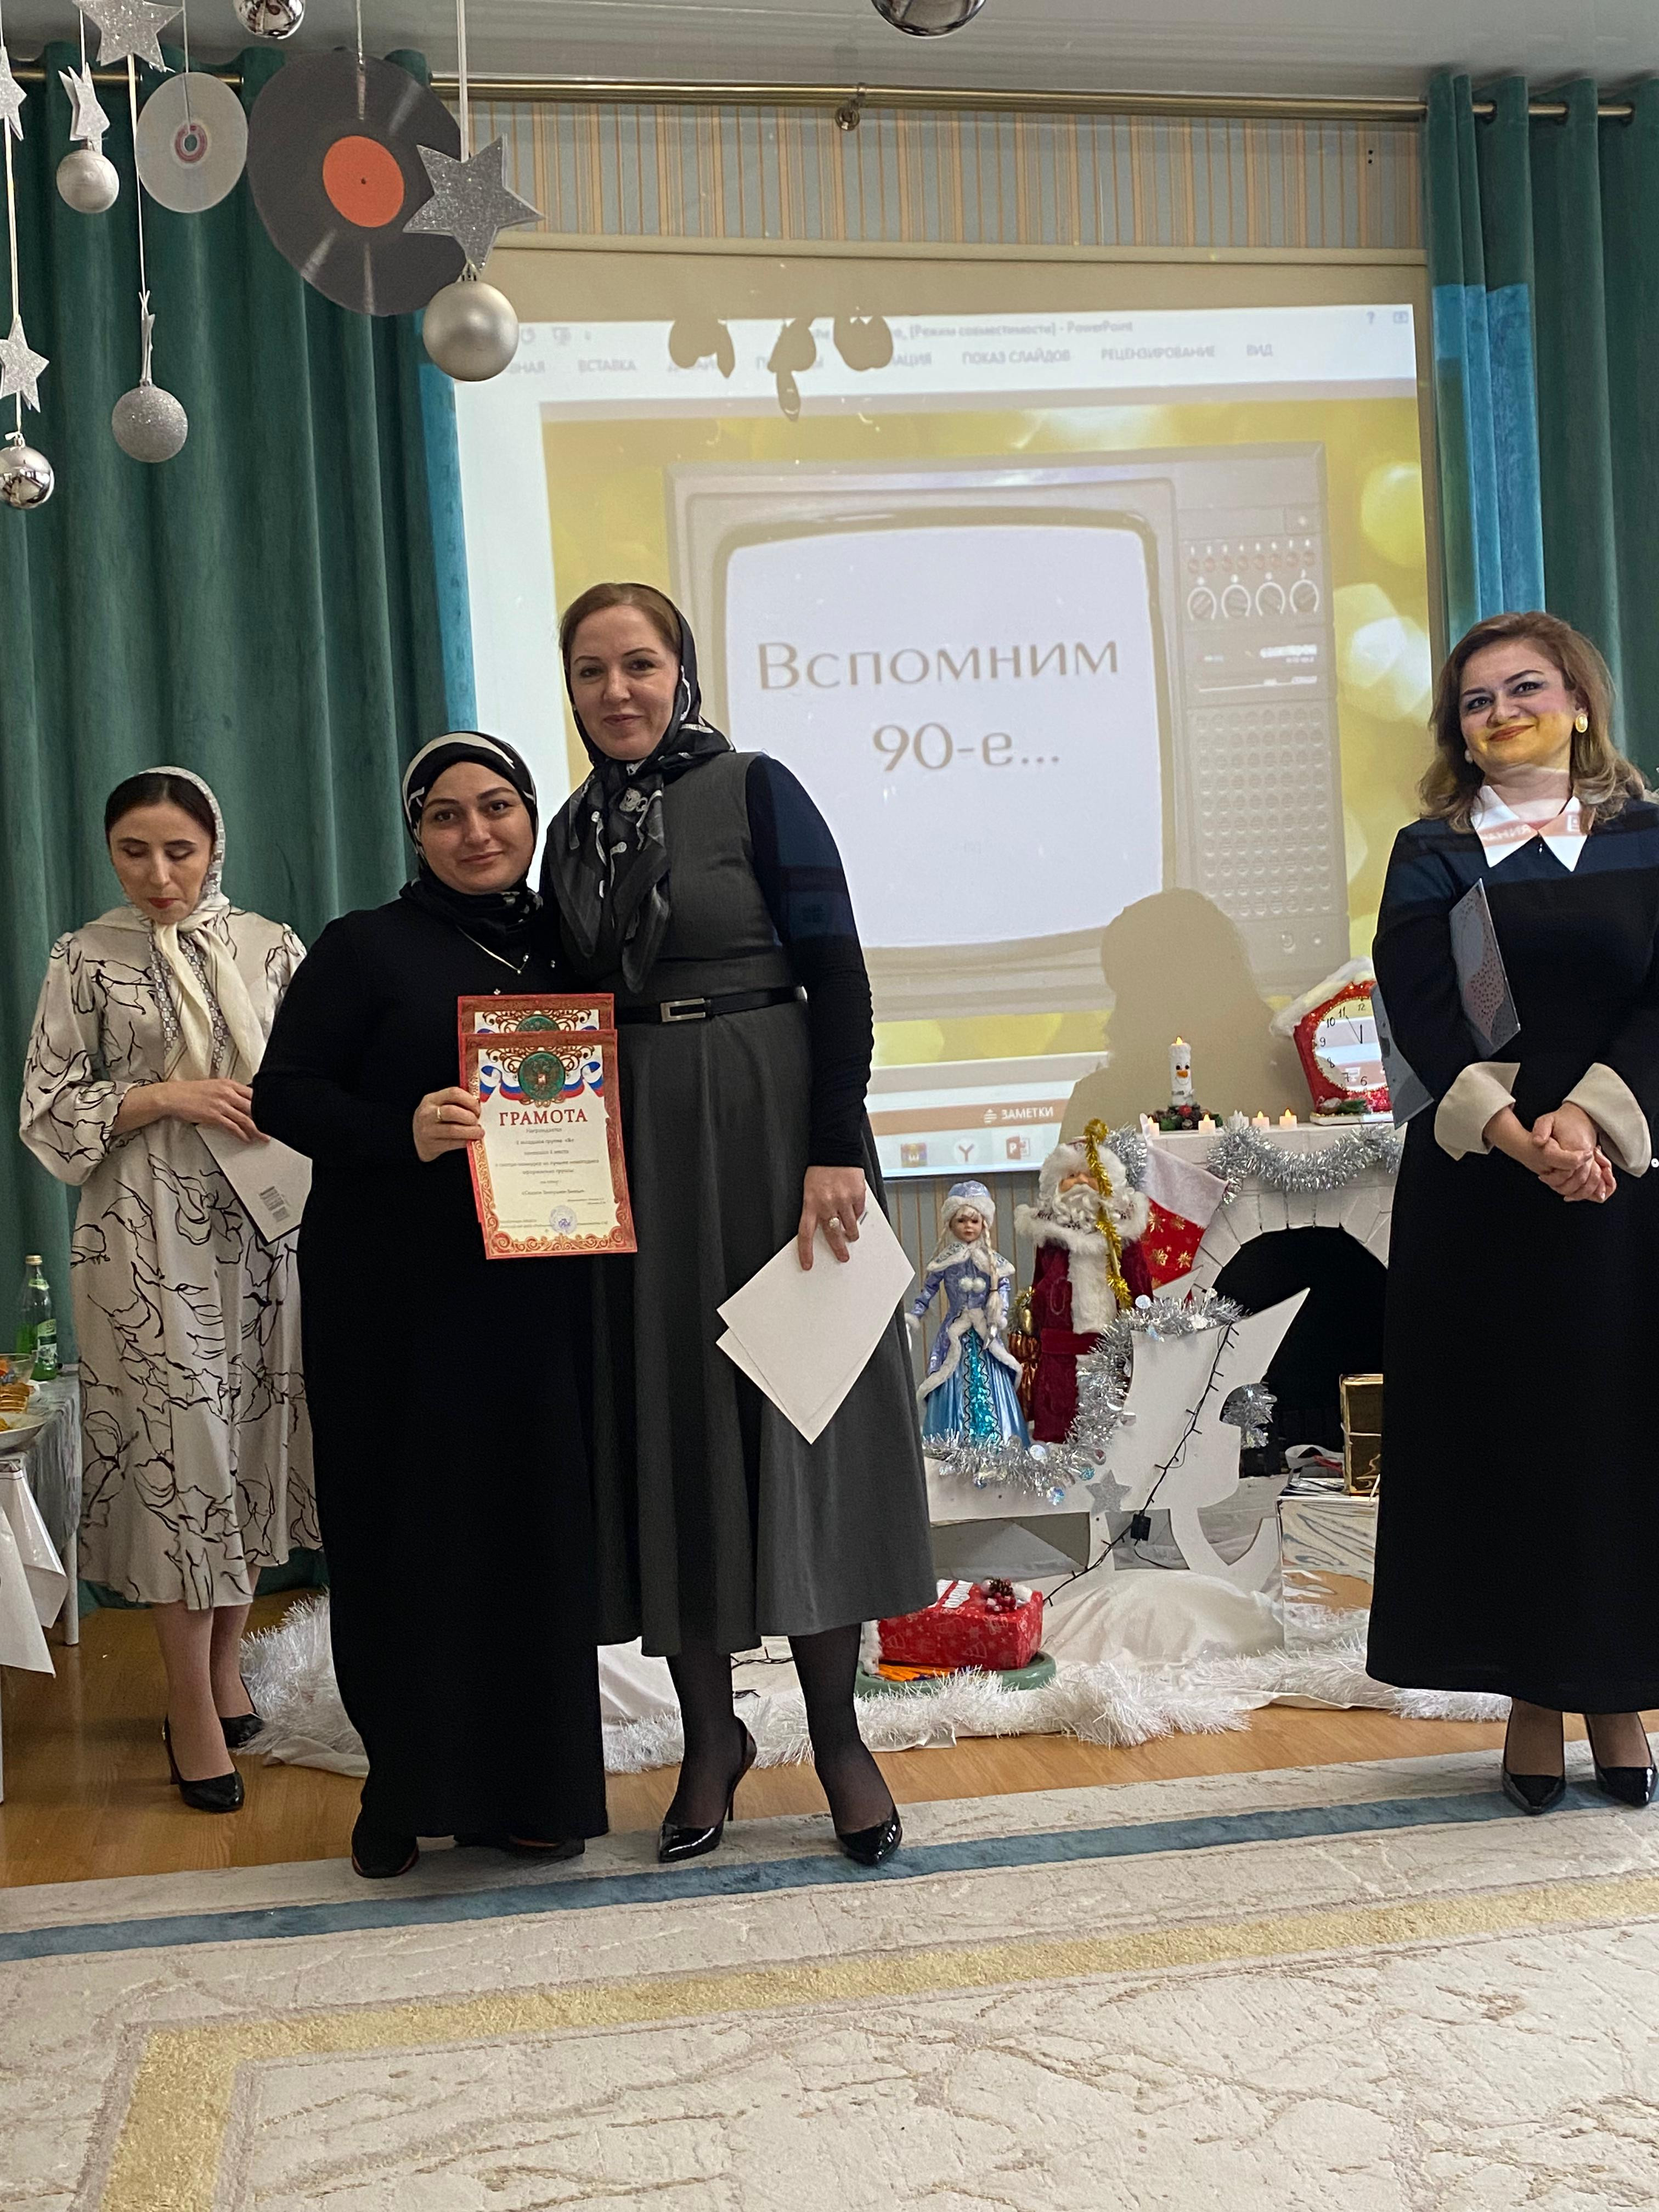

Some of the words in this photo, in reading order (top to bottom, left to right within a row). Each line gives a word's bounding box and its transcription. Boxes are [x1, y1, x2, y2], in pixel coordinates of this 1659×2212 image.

[962, 350, 1006, 365] ПОКАЗ
[1009, 347, 1070, 364] СЛАЙДОВ
[1101, 345, 1215, 360] РЕЦЕНЗИРОВАНИЕ
[1246, 343, 1273, 358] ВИД
[578, 359, 636, 374] ВСТАВКА
[757, 640, 1119, 690] Вспомним
[872, 721, 1060, 771] 90-е...
[1339, 1007, 1345, 1018] 11
[1327, 1017, 1335, 1028] 10
[1319, 1037, 1326, 1047] 9
[1327, 1057, 1335, 1068] 8
[1342, 1073, 1350, 1082] 7
[1361, 1076, 1368, 1086] 6
[499, 1108, 588, 1126] ГРАМОТА
[1001, 1106, 1054, 1121] ЗАМЕТКИ
